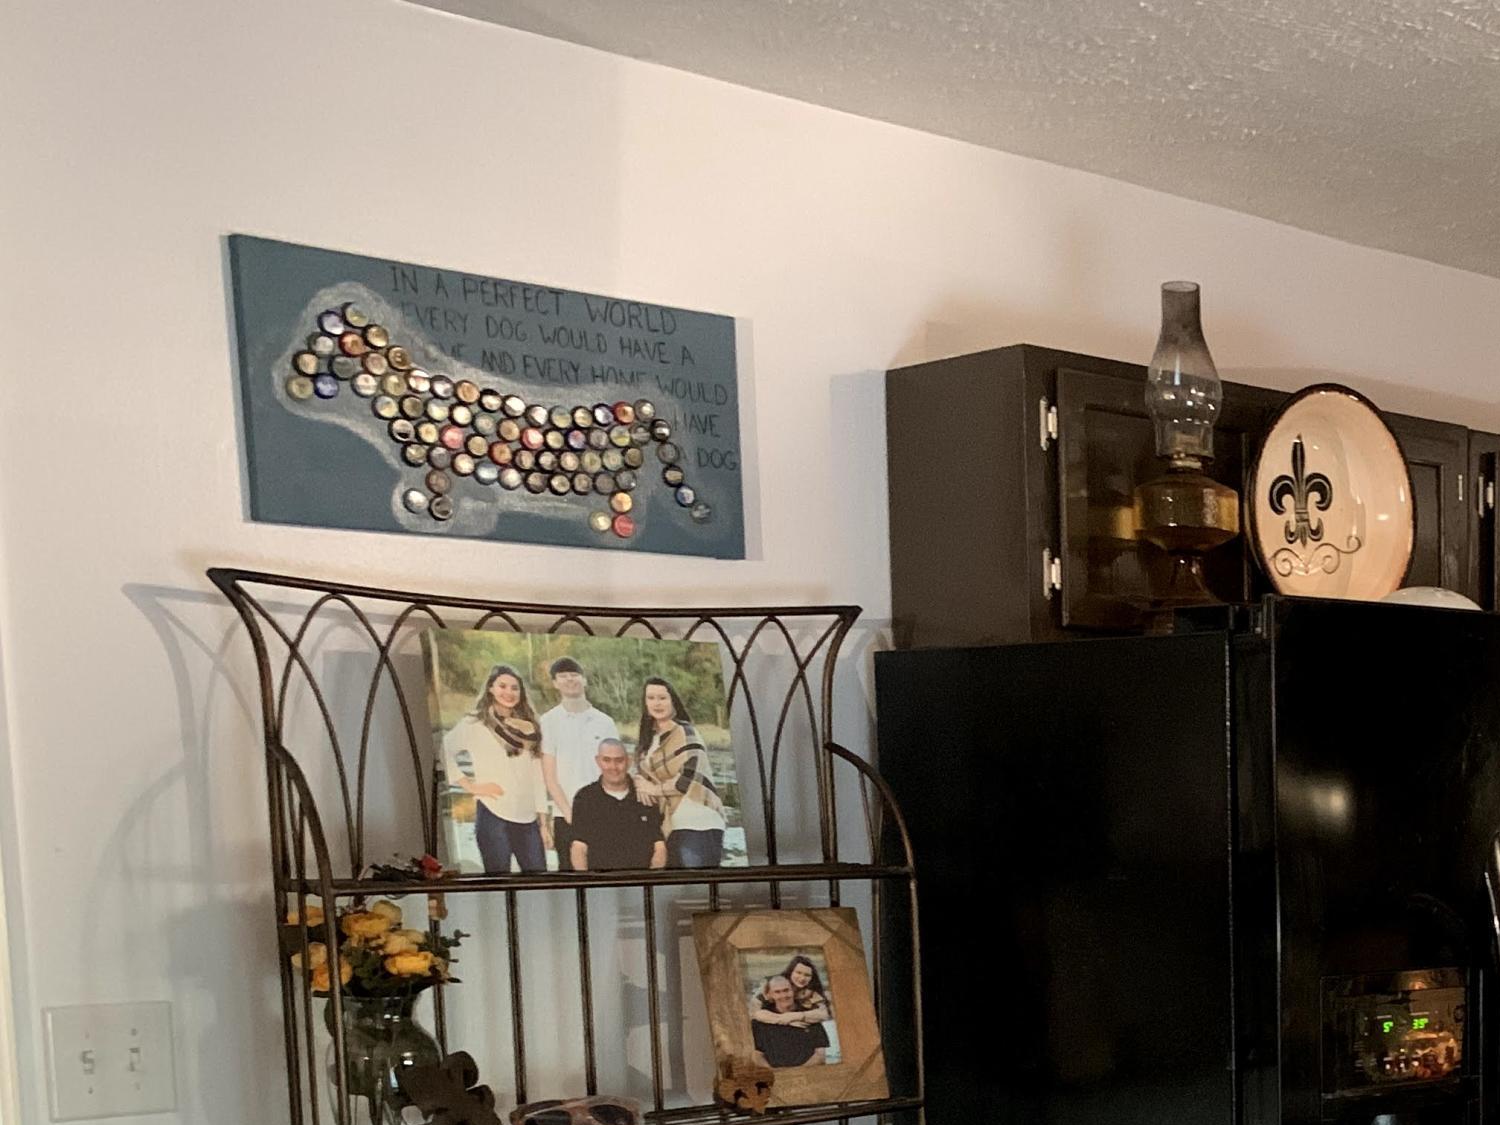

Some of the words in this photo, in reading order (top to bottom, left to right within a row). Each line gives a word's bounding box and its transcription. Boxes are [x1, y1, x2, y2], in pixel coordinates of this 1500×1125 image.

[390, 265, 419, 295] IN
[435, 272, 449, 299] A
[461, 277, 566, 316] PERFECT
[584, 297, 678, 336] WORLD
[402, 301, 469, 334] EVERY
[485, 314, 528, 343] DOG
[538, 323, 608, 354] WOULD
[619, 335, 671, 365] HAVE
[681, 345, 695, 367] A
[481, 349, 516, 376] AND
[522, 354, 581, 386] EVERY
[656, 374, 729, 407] WOULD
[672, 407, 721, 439] HAVE
[696, 446, 738, 471] DOG
